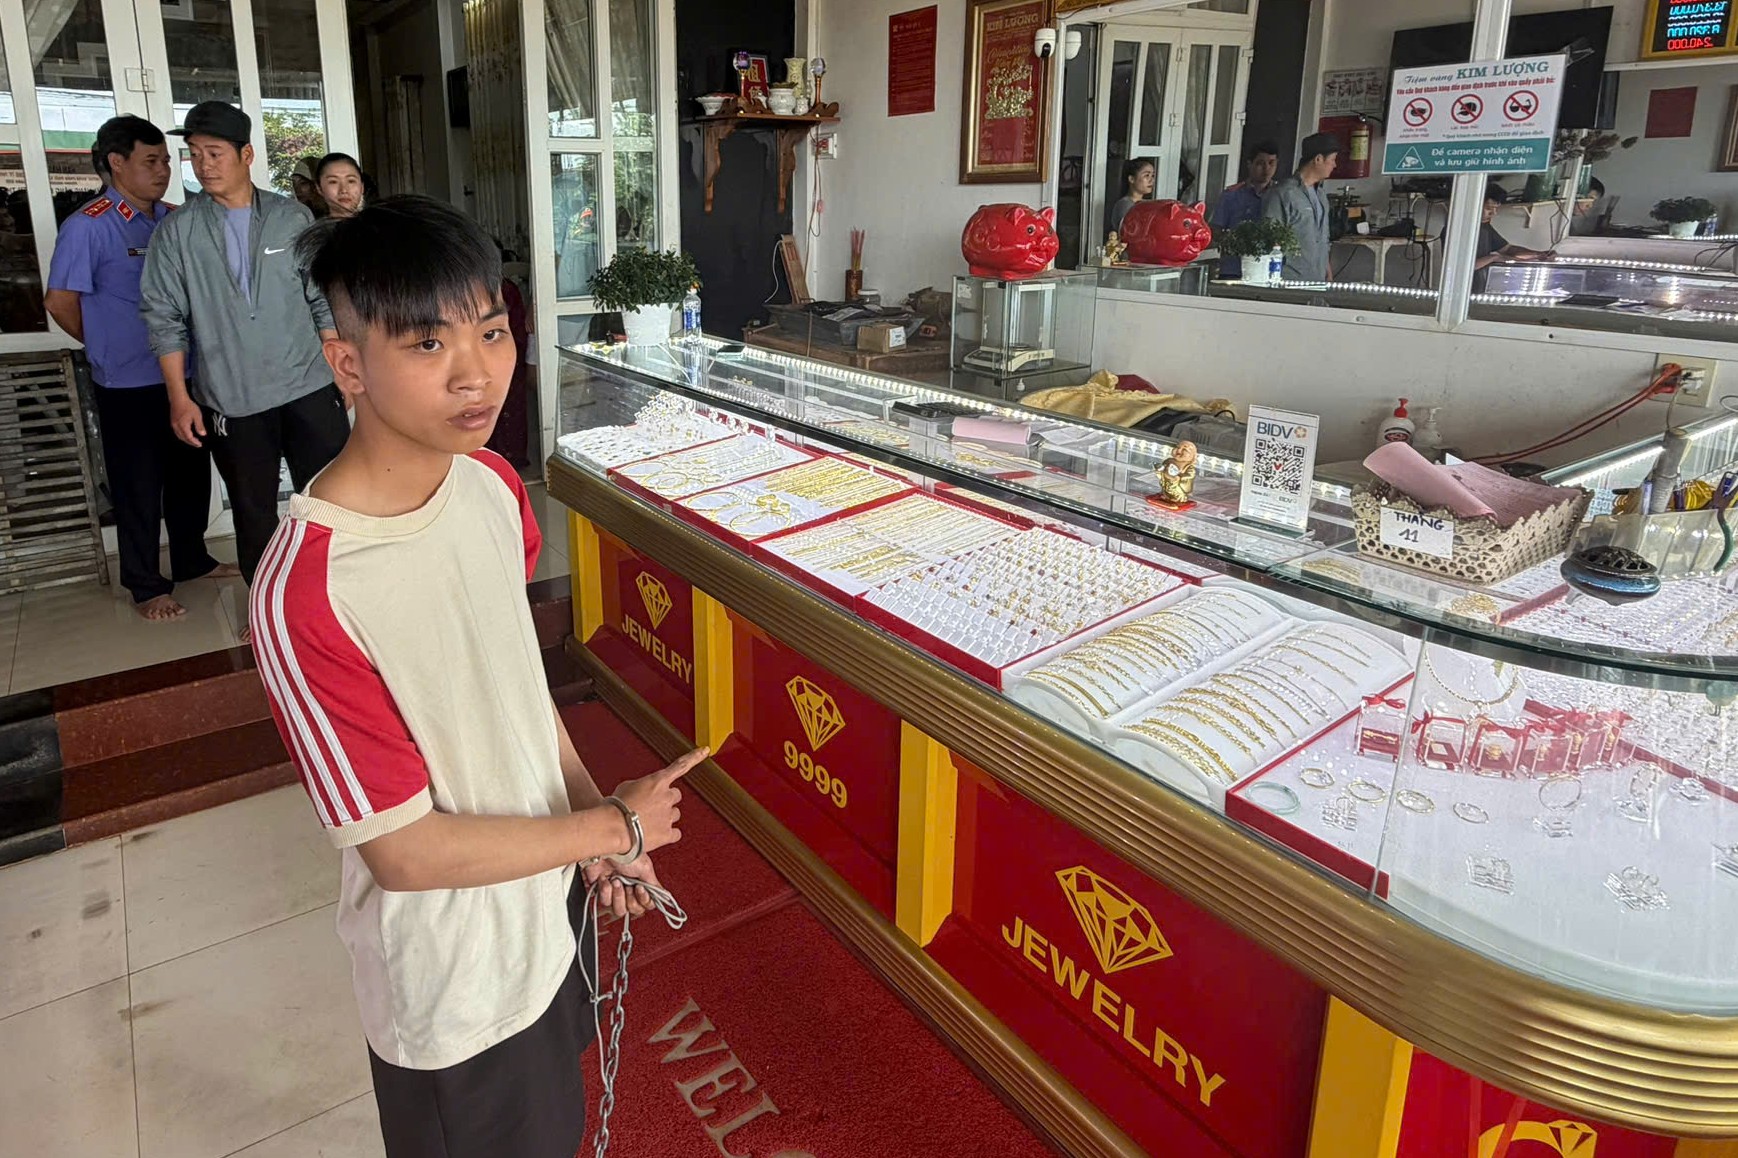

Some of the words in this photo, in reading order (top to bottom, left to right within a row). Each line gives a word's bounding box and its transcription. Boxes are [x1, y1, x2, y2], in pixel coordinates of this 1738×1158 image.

[1456, 66, 1488, 79] KIM
[1492, 61, 1549, 78] LƯỢNG
[1511, 146, 1533, 155] diện
[1256, 421, 1294, 440] BIDV
[1398, 528, 1419, 543] 11
[621, 614, 692, 685] JEWELRY
[783, 740, 848, 809] 9999
[1001, 915, 1227, 1108] JEWELRY
[646, 997, 817, 1158] WEL
